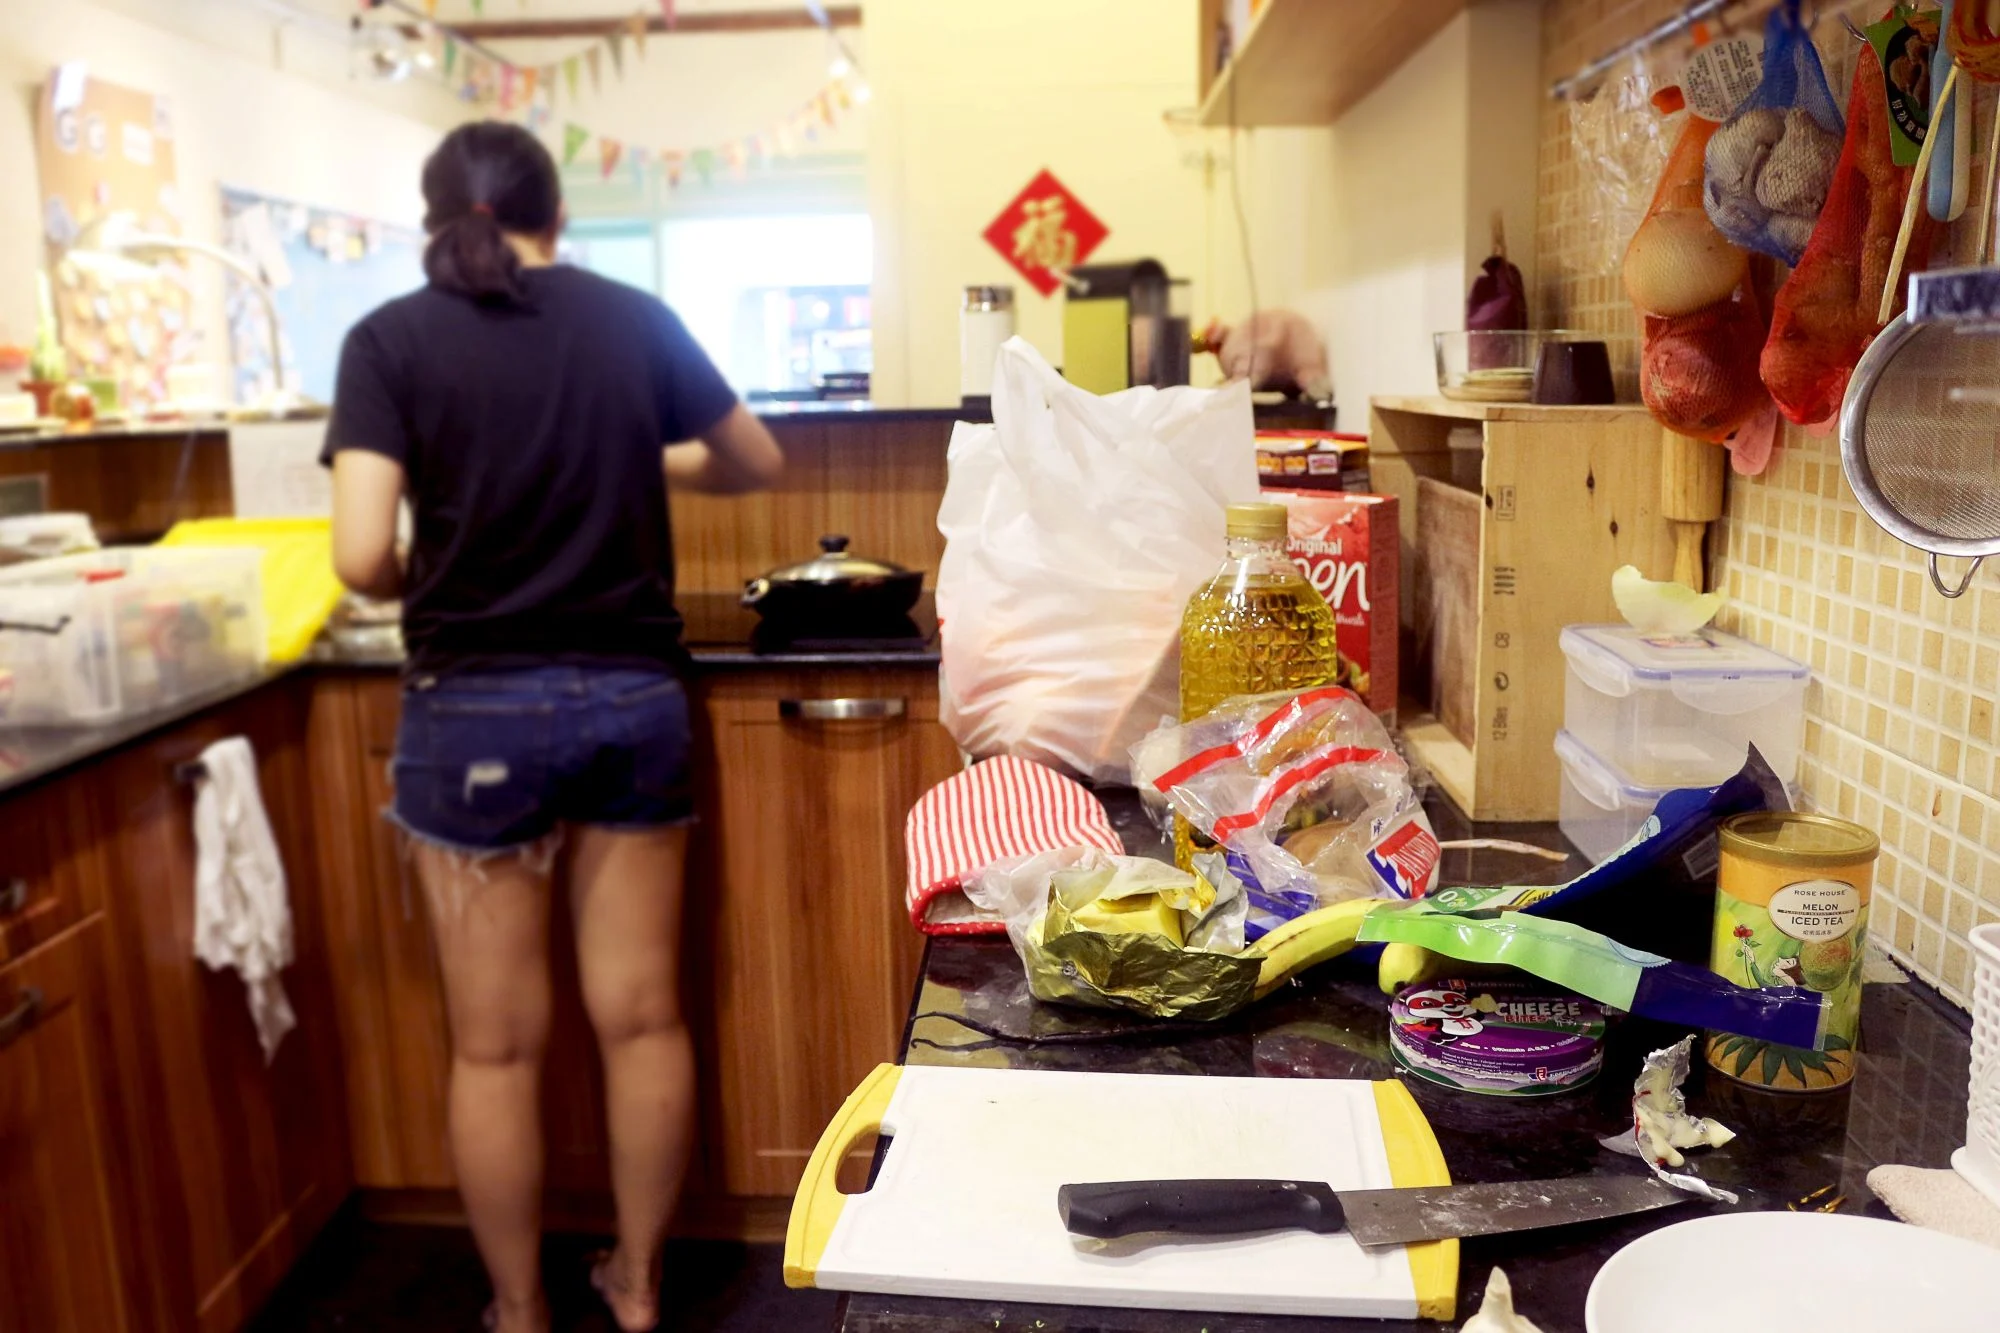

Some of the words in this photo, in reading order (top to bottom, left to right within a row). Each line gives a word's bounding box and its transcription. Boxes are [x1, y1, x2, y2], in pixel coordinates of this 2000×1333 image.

[1012, 195, 1077, 271] 福
[1819, 889, 1846, 897] HOUSE
[1802, 903, 1839, 911] MELON
[1791, 916, 1820, 926] ICED
[1823, 916, 1844, 926] TEA
[1495, 1001, 1581, 1017] CHEESE
[1503, 1014, 1548, 1024] BITES
